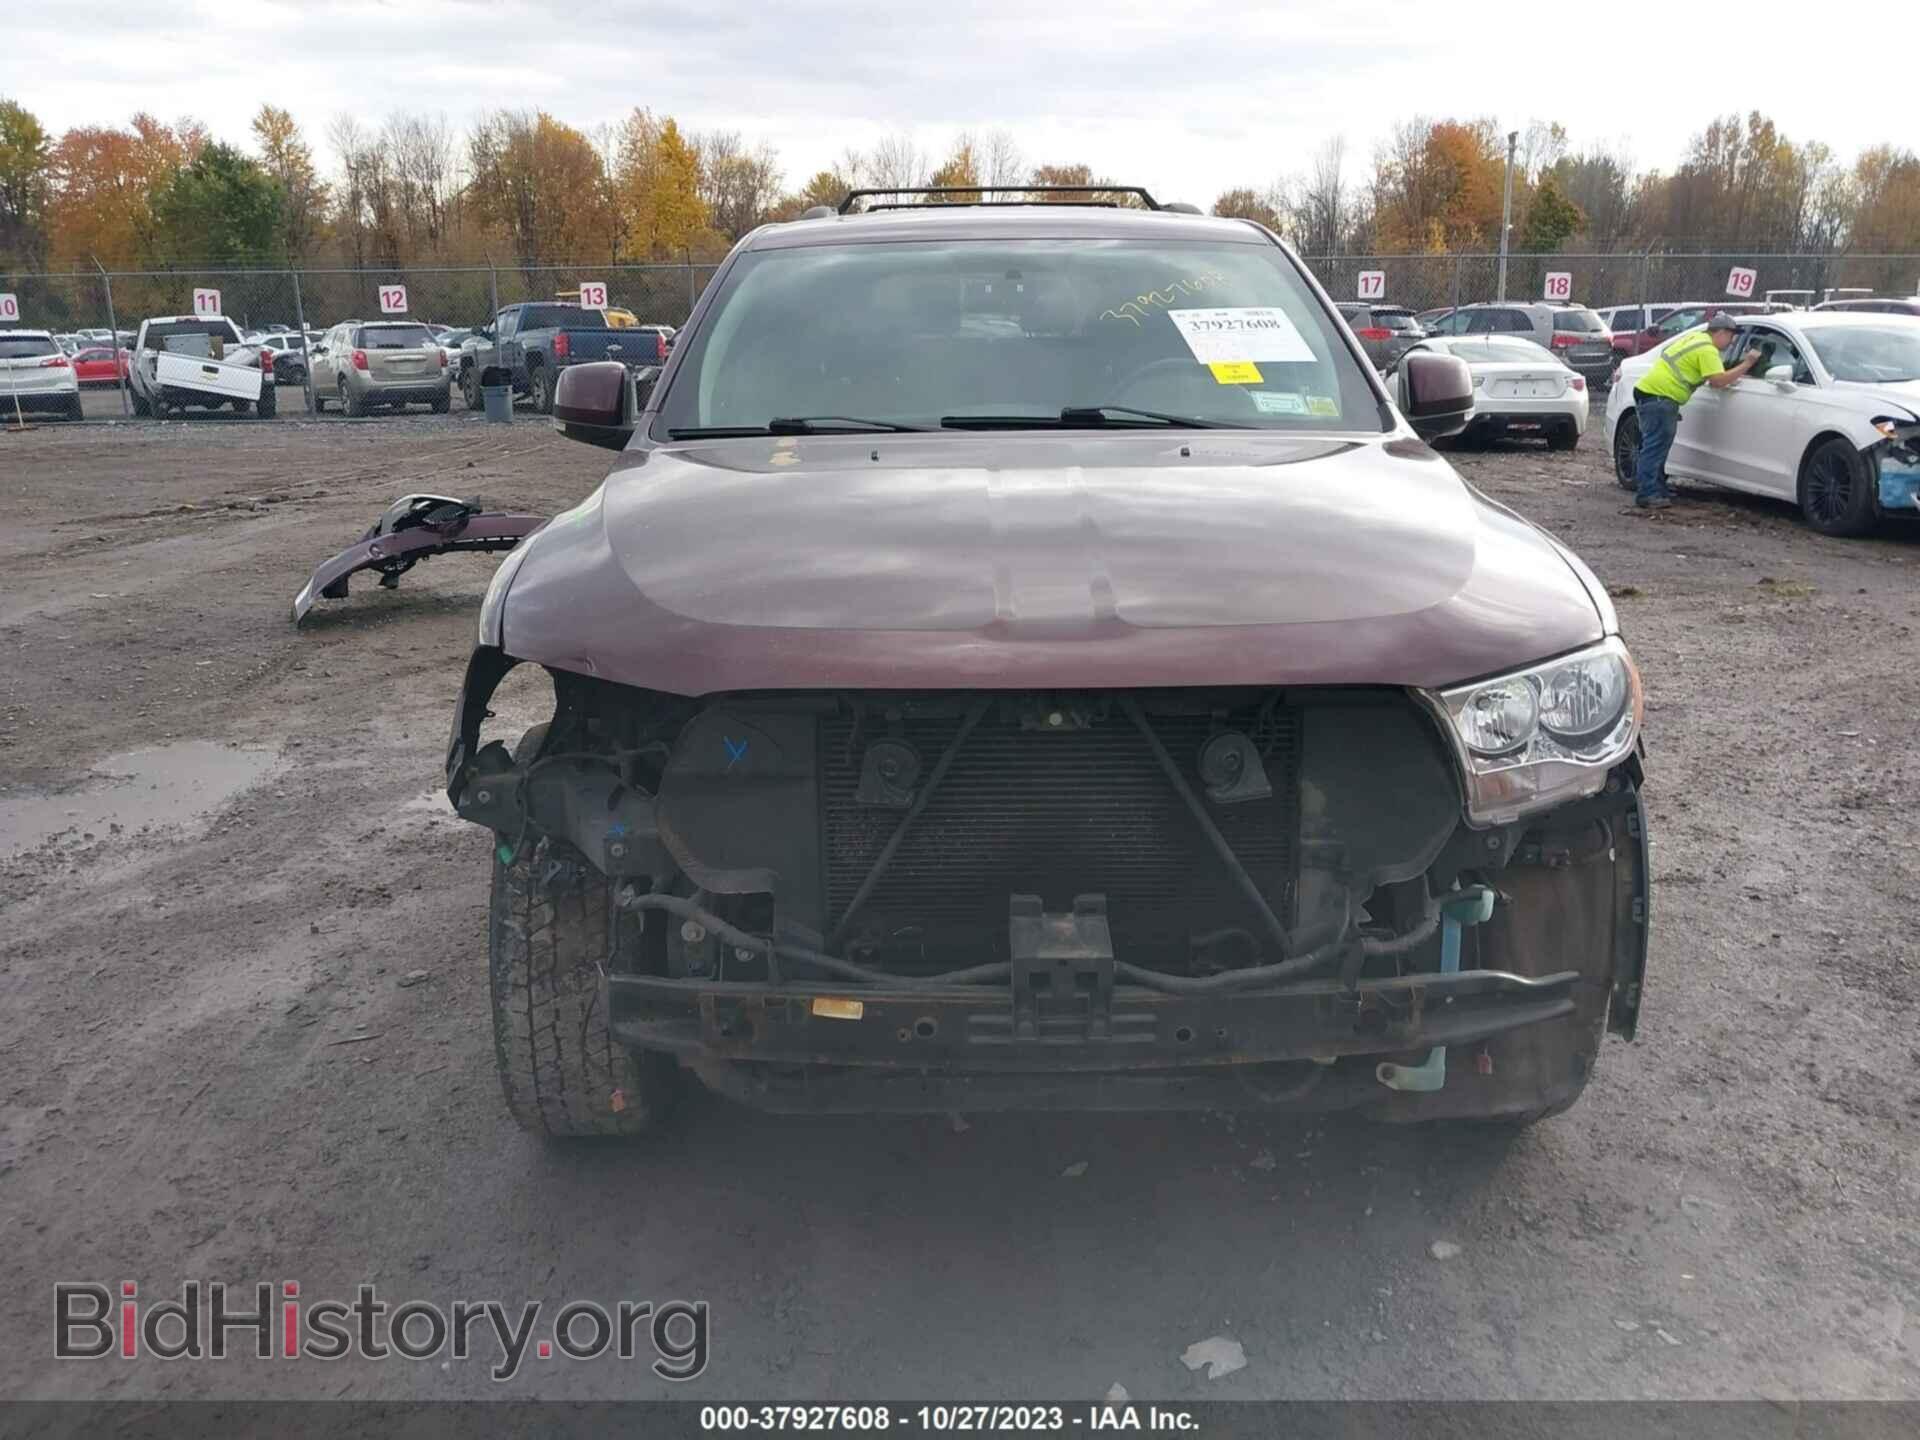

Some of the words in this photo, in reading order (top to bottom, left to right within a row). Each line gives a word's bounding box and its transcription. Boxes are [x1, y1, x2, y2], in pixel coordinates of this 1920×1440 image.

[1361, 276, 1382, 294] 17
[1547, 277, 1568, 295] 18
[1732, 272, 1752, 292] 19
[197, 294, 217, 312] 11
[382, 290, 405, 308] 12
[583, 287, 604, 305] 13
[0, 299, 15, 316] 0
[1190, 319, 1281, 331] 37927608
